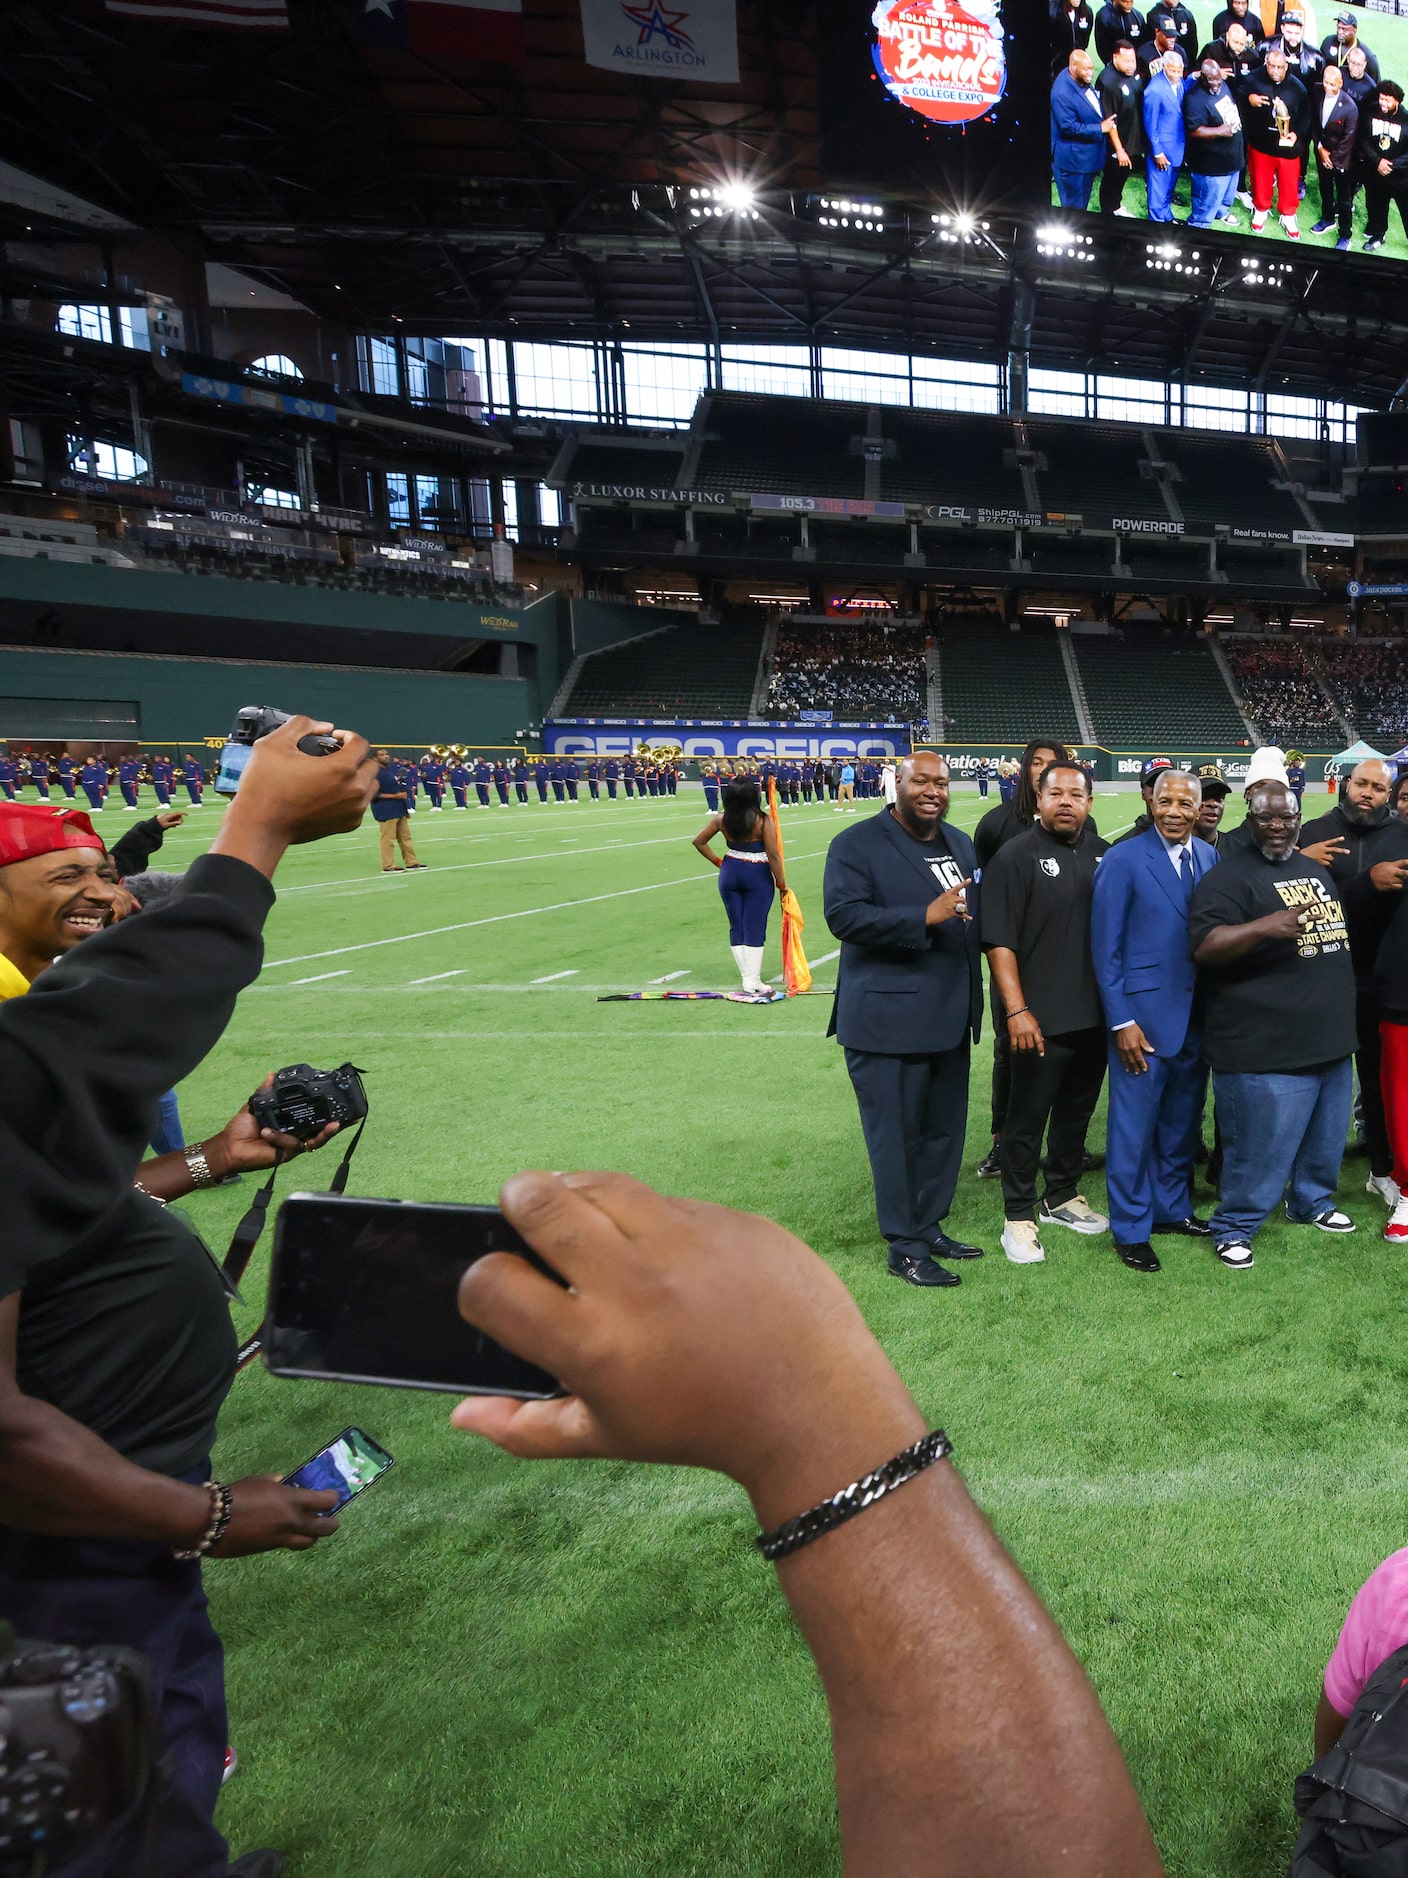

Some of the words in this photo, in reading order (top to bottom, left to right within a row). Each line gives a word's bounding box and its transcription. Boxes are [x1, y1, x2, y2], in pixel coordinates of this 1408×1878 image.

[899, 12, 939, 27] ROLAND
[942, 20, 985, 36] PARRISH
[878, 19, 942, 48] BATTLE
[944, 30, 969, 52] OF
[969, 34, 1004, 59] THE
[613, 44, 706, 66] ARLINGTON
[894, 40, 998, 87] Bands
[932, 79, 983, 91] INVITATIONAL
[902, 87, 910, 95] &
[912, 87, 955, 99] COLLEGE
[958, 92, 984, 102] EXPO
[591, 485, 645, 498] LUXOR
[650, 488, 726, 504] STAFFING
[780, 497, 814, 510] 105.3
[819, 501, 844, 512] THE
[238, 514, 260, 527] RAG
[938, 506, 971, 519] PGL
[978, 508, 1041, 520] ShipPGL.com
[978, 515, 1041, 526] 877.701.1919
[1113, 518, 1185, 534] POWERADE
[1234, 529, 1250, 538] Real
[1251, 529, 1267, 539] fans
[1268, 531, 1290, 540] know.
[554, 736, 725, 764] GEICO
[737, 738, 896, 764] GEICO
[1276, 883, 1321, 907] BACK
[1310, 878, 1332, 903] 2
[1297, 932, 1321, 946] STATE
